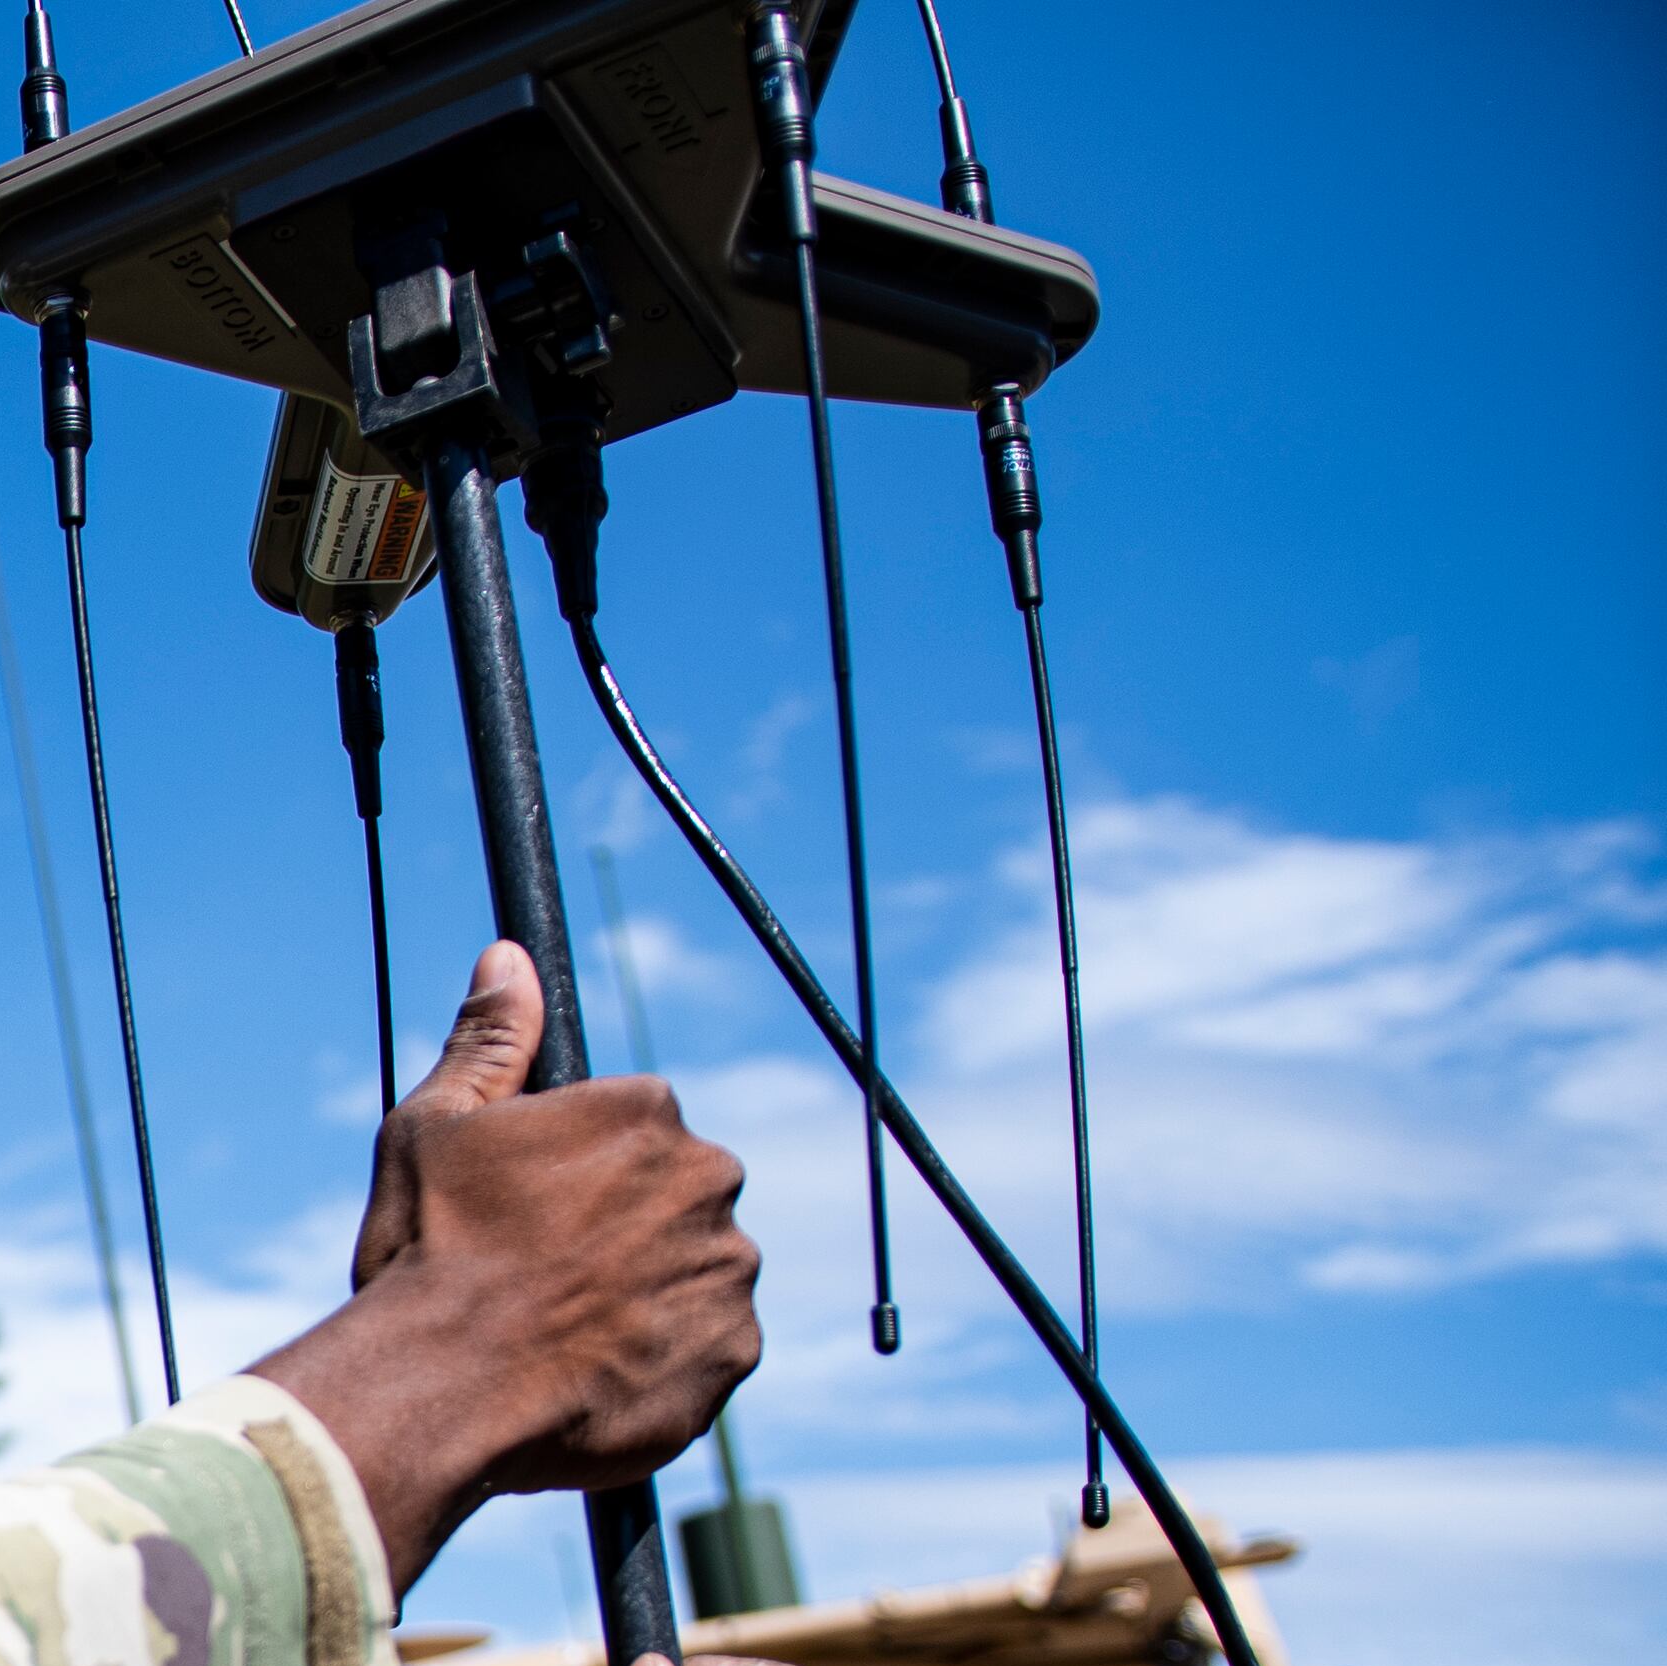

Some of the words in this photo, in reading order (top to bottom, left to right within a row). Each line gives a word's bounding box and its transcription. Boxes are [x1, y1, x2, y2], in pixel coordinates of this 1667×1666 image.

[616, 62, 701, 151] FRONT
[171, 251, 275, 351] BOTTOM
[355, 519, 375, 557] Protection
[366, 503, 380, 518] Eye
[377, 500, 419, 576] WARNING
